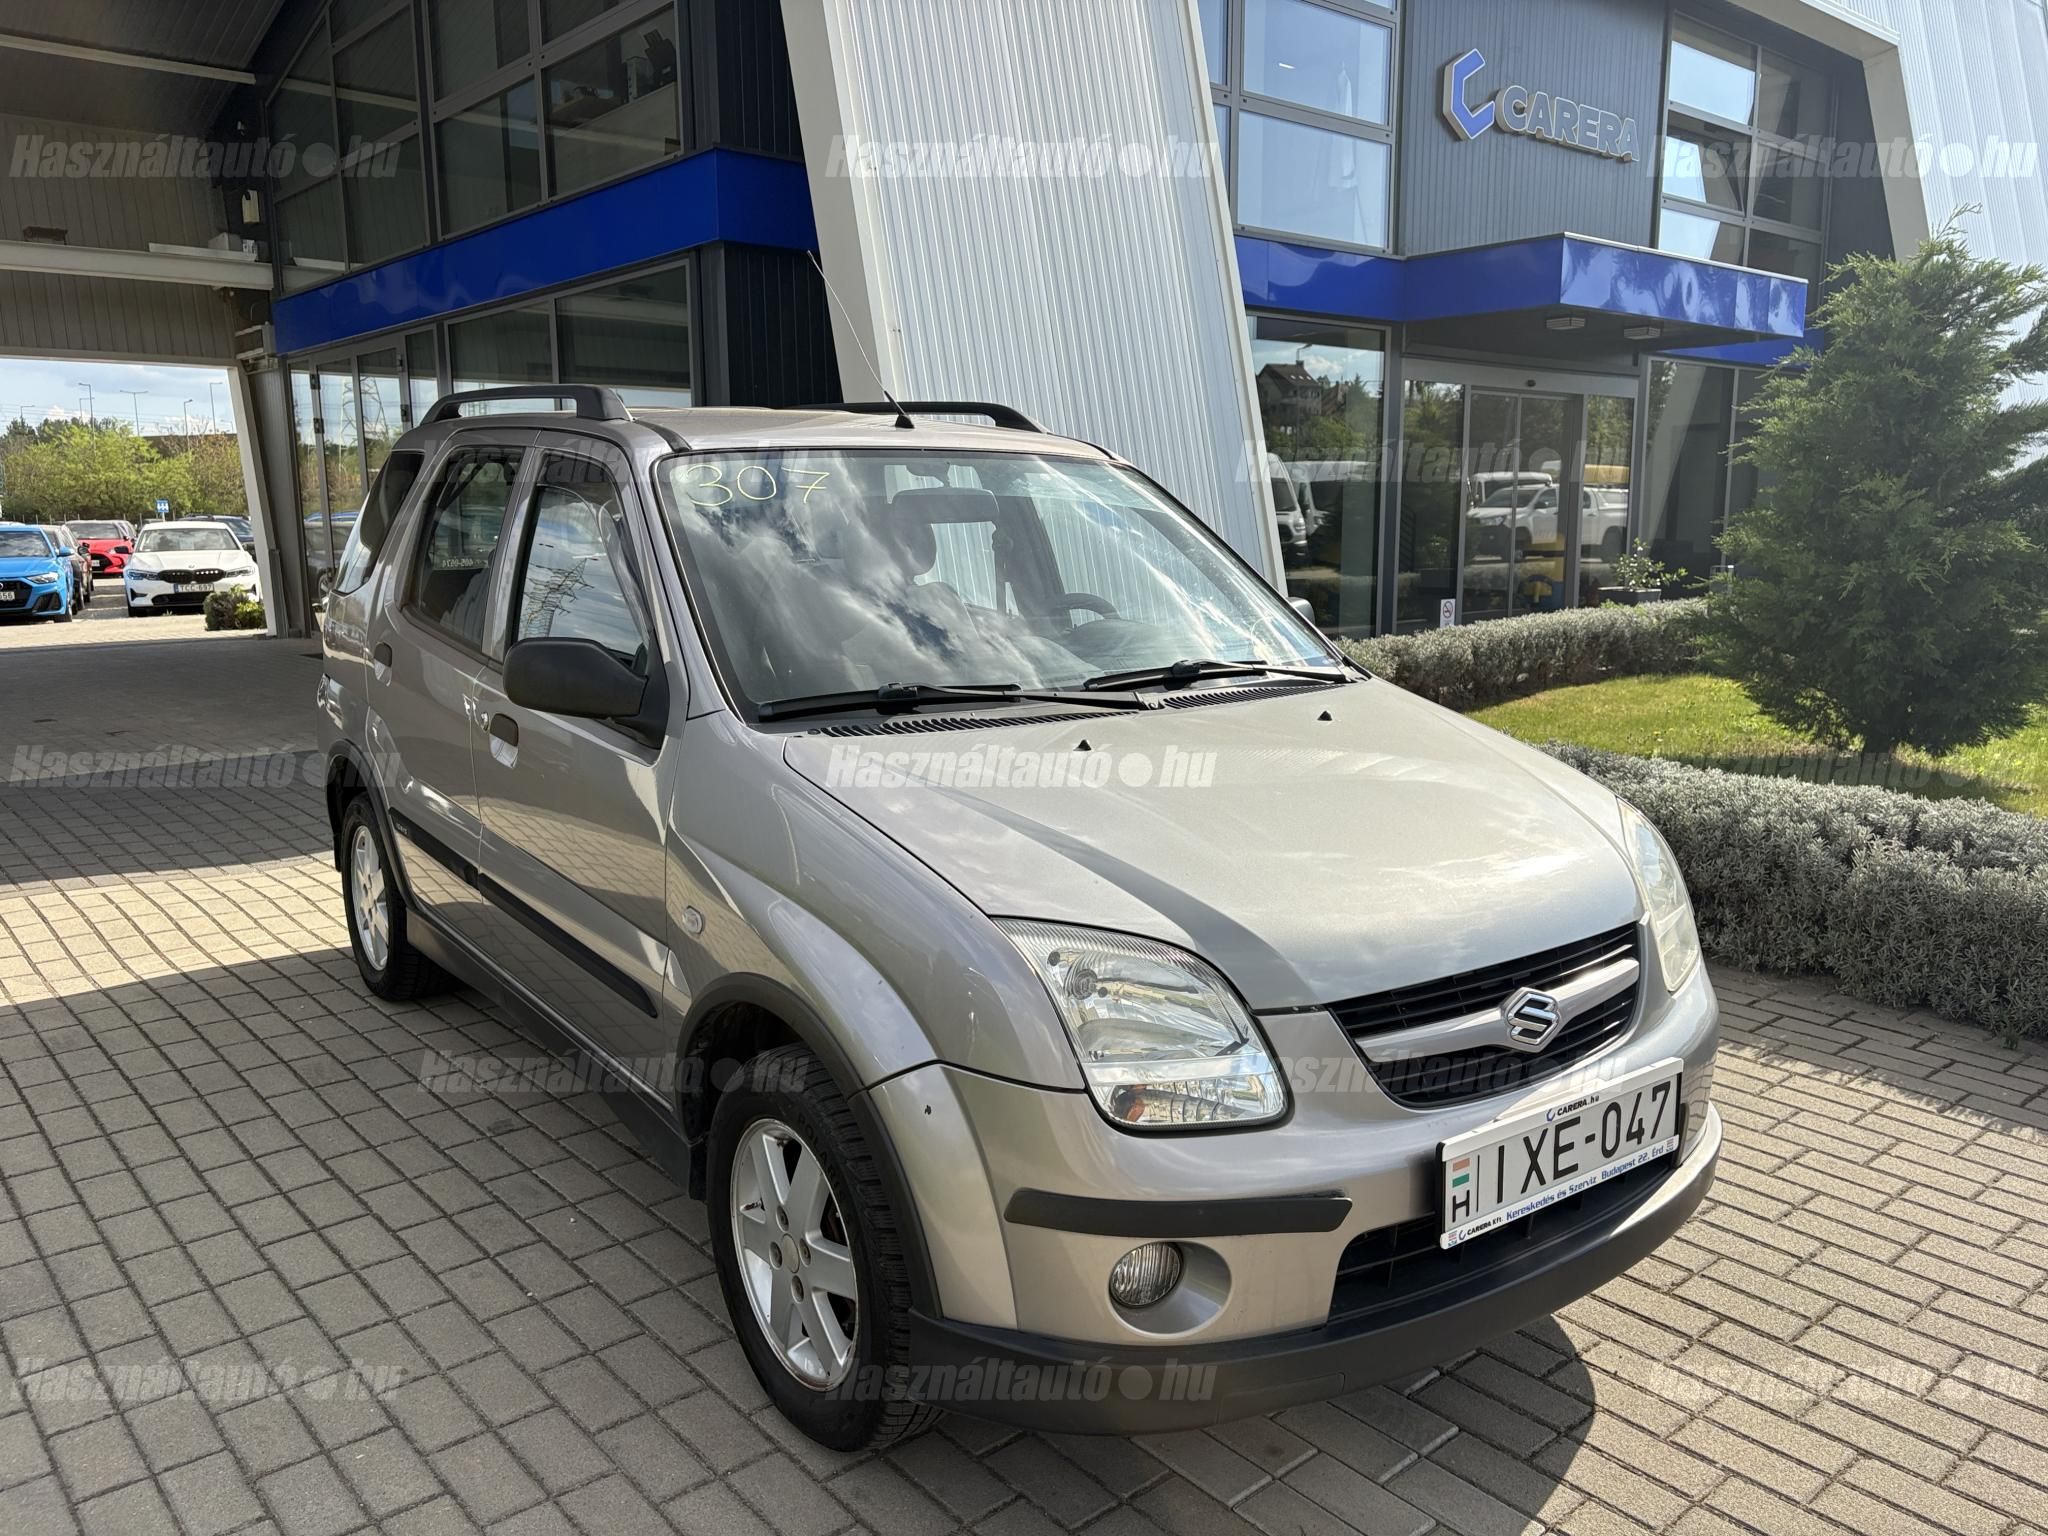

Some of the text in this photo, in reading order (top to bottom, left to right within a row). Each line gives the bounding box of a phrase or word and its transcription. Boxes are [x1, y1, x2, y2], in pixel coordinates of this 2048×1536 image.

[1500, 84, 1641, 163] CARERA
[685, 464, 830, 507] 307
[1556, 1094, 1600, 1116] CARERA.hu
[1496, 1080, 1671, 1204] IXE-047
[1451, 1189, 1470, 1223] H
[1467, 1221, 1491, 1236] CARERA
[1506, 1191, 1555, 1221] Kereskedés
[1556, 1187, 1567, 1200] és
[1569, 1176, 1597, 1195] Szerviz
[1601, 1157, 1636, 1180] Budapest
[1651, 1145, 1664, 1158] Érd
